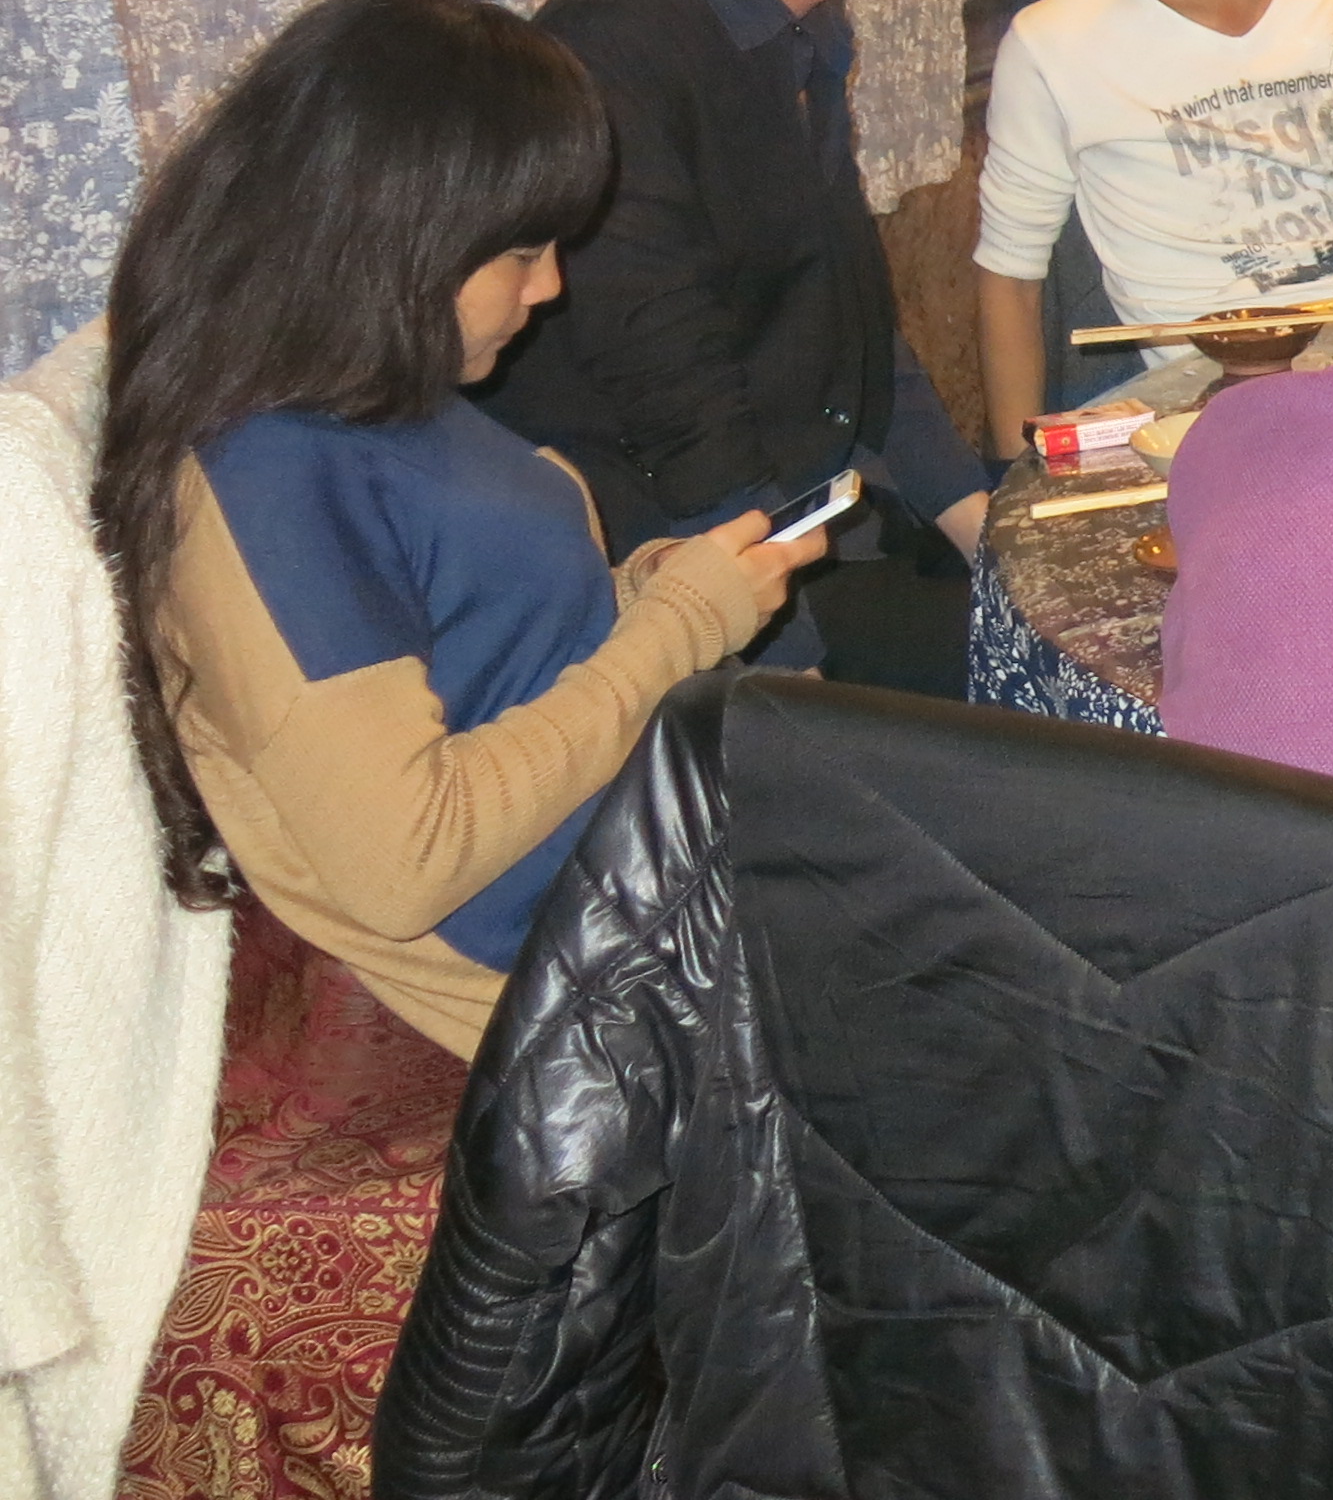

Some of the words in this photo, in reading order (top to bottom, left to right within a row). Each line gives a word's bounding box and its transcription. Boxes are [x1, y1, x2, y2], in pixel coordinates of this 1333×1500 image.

[1151, 107, 1182, 124] The
[1184, 88, 1222, 120] wind
[1223, 80, 1254, 106] that
